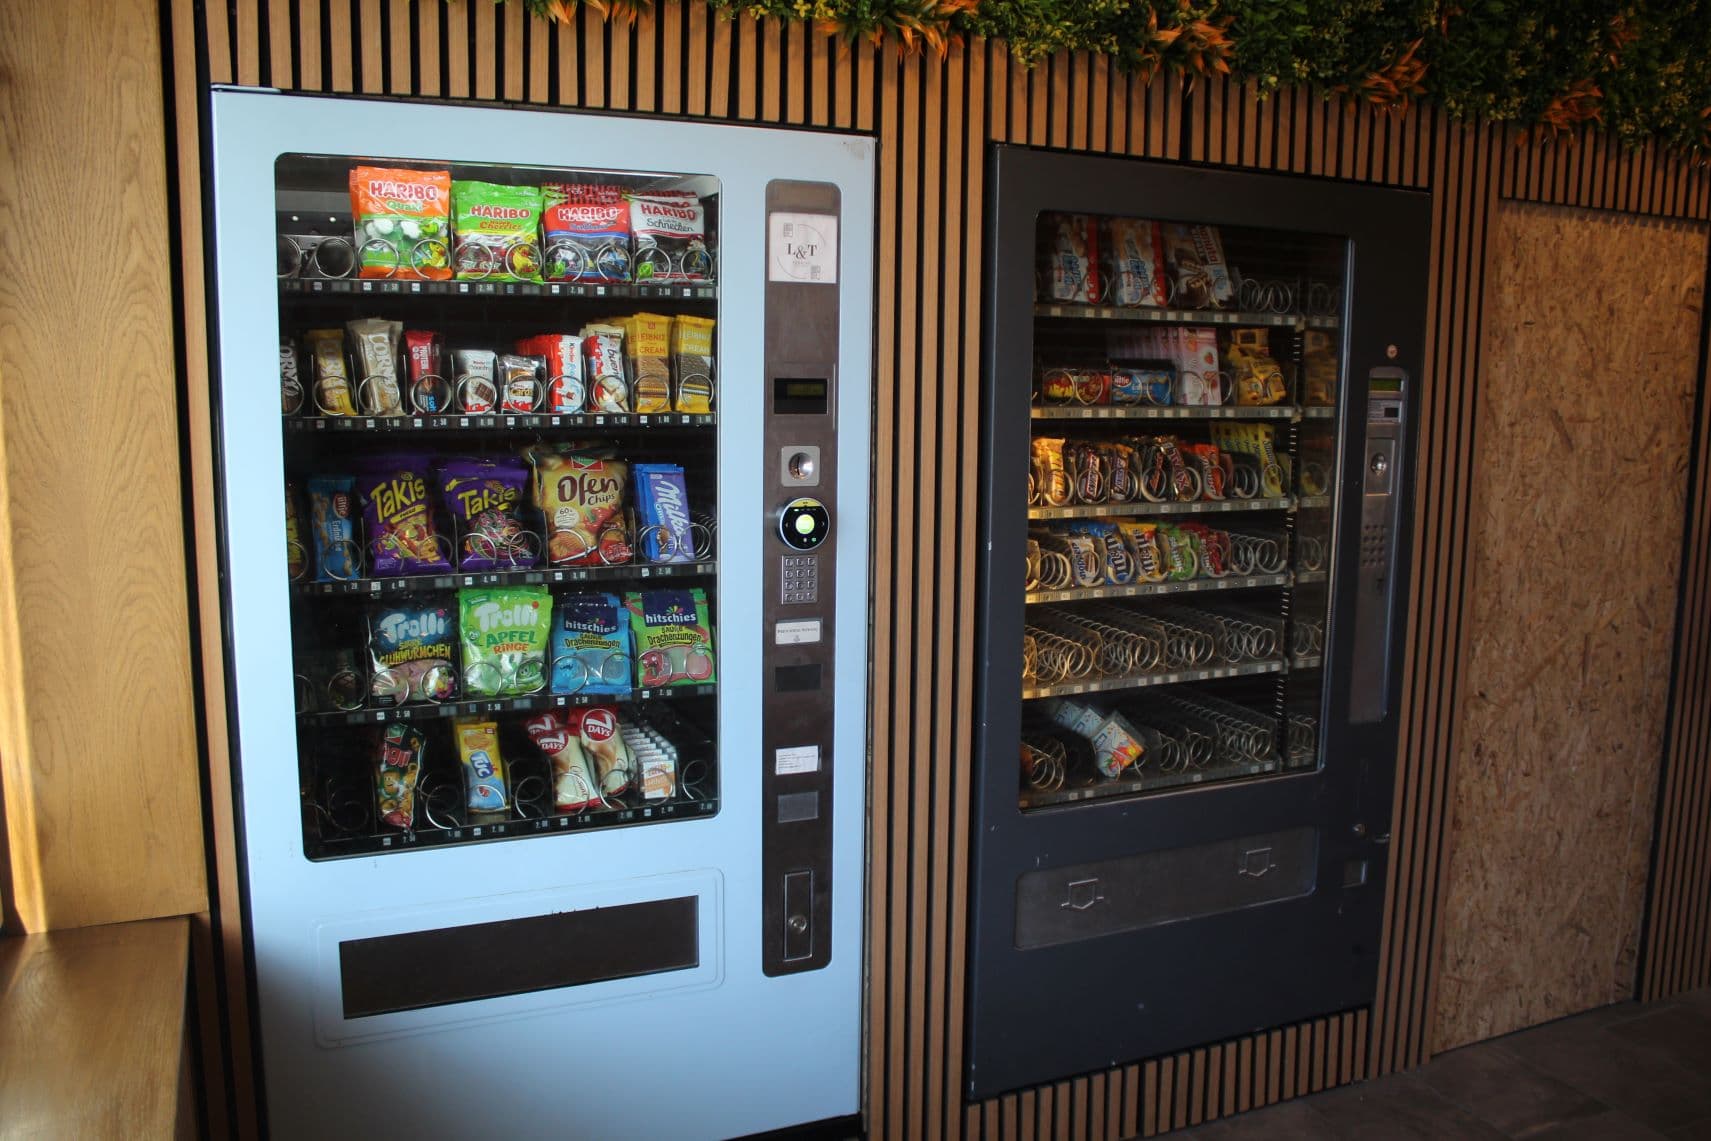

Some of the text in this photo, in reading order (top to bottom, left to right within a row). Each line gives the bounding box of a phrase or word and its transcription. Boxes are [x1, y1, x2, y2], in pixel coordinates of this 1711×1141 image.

[369, 180, 438, 201] HARIBO
[471, 204, 530, 219] HARIBO
[558, 206, 618, 221] HARIBO
[641, 203, 697, 221] HARIBO
[639, 332, 665, 342] LEIBNIZ
[639, 346, 665, 355] CREAM
[280, 345, 300, 397] ORNY
[557, 473, 618, 505] Ofen
[370, 478, 426, 523] Takis
[458, 486, 518, 520] Takis
[588, 493, 616, 506] Chips
[656, 480, 689, 538] Milka
[474, 601, 539, 632] Trolli
[645, 612, 697, 624] hitschies
[379, 609, 445, 643] Trolli
[565, 619, 617, 633] hitschies
[486, 630, 537, 648] APFEL
[565, 637, 621, 648] Drachenzungen
[647, 633, 701, 646] Drachenzungen
[585, 713, 613, 730] 7
[587, 725, 611, 736] DAYS
[541, 742, 565, 750] DAYS
[471, 752, 491, 778] TUC
